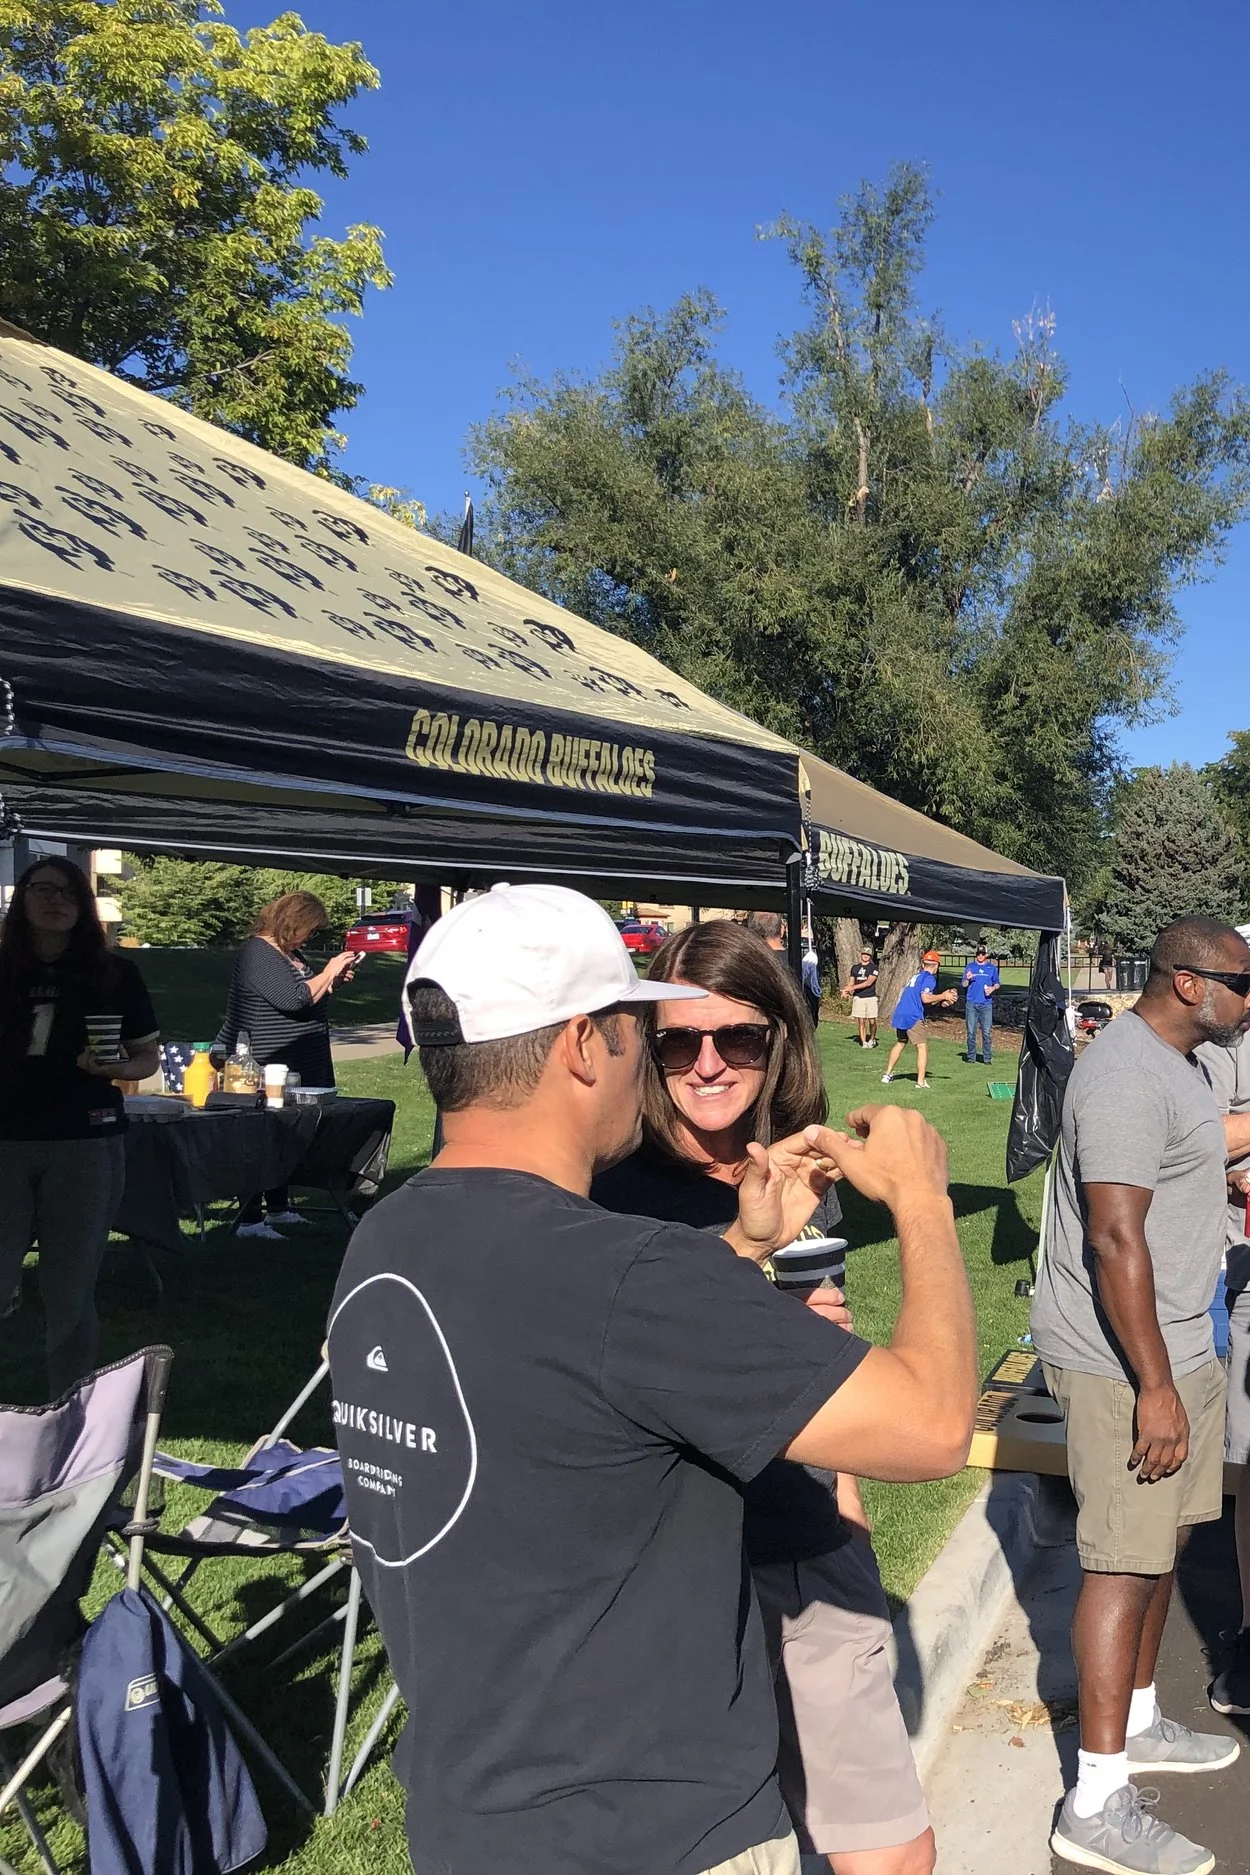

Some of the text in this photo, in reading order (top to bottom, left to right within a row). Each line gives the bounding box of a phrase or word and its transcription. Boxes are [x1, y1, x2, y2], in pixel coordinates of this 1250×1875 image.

[405, 709, 656, 797] COLORADO BUFFALOES
[818, 830, 909, 894] BUFFALOES
[27, 1004, 55, 1056] 1
[331, 1400, 437, 1452] QUIKSILVER
